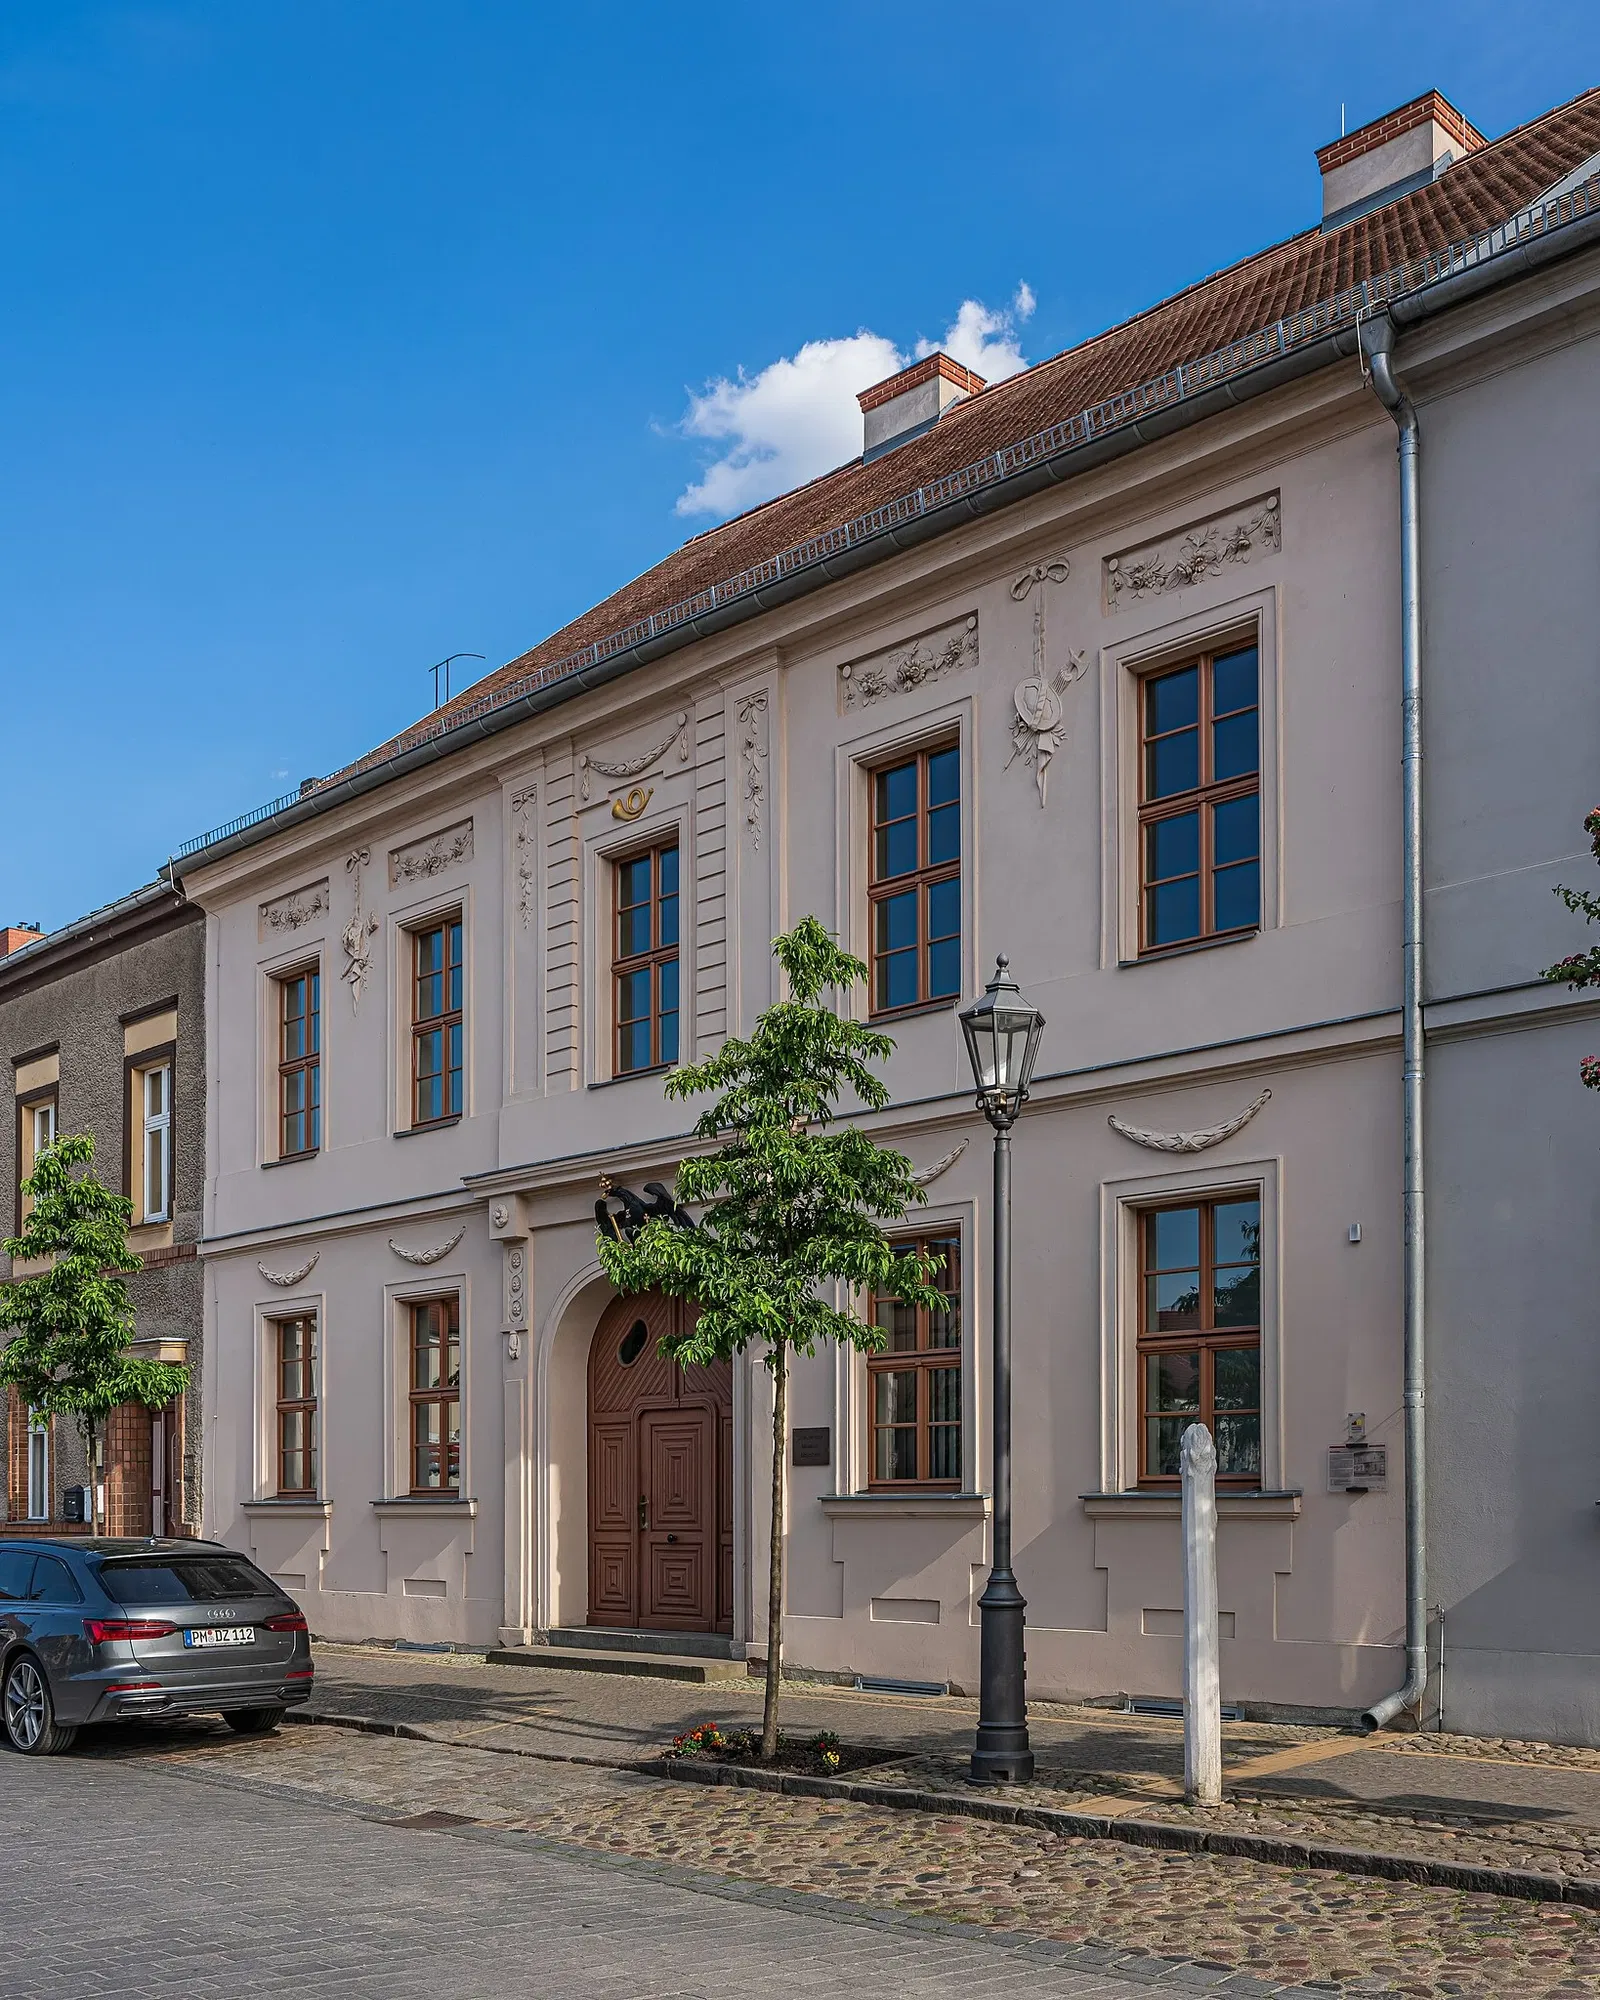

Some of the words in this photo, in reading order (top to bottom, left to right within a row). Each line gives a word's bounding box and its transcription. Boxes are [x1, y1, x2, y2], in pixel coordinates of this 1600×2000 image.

[192, 1631, 208, 1643] PM
[215, 1629, 230, 1642] DZ
[233, 1628, 253, 1641] 112
